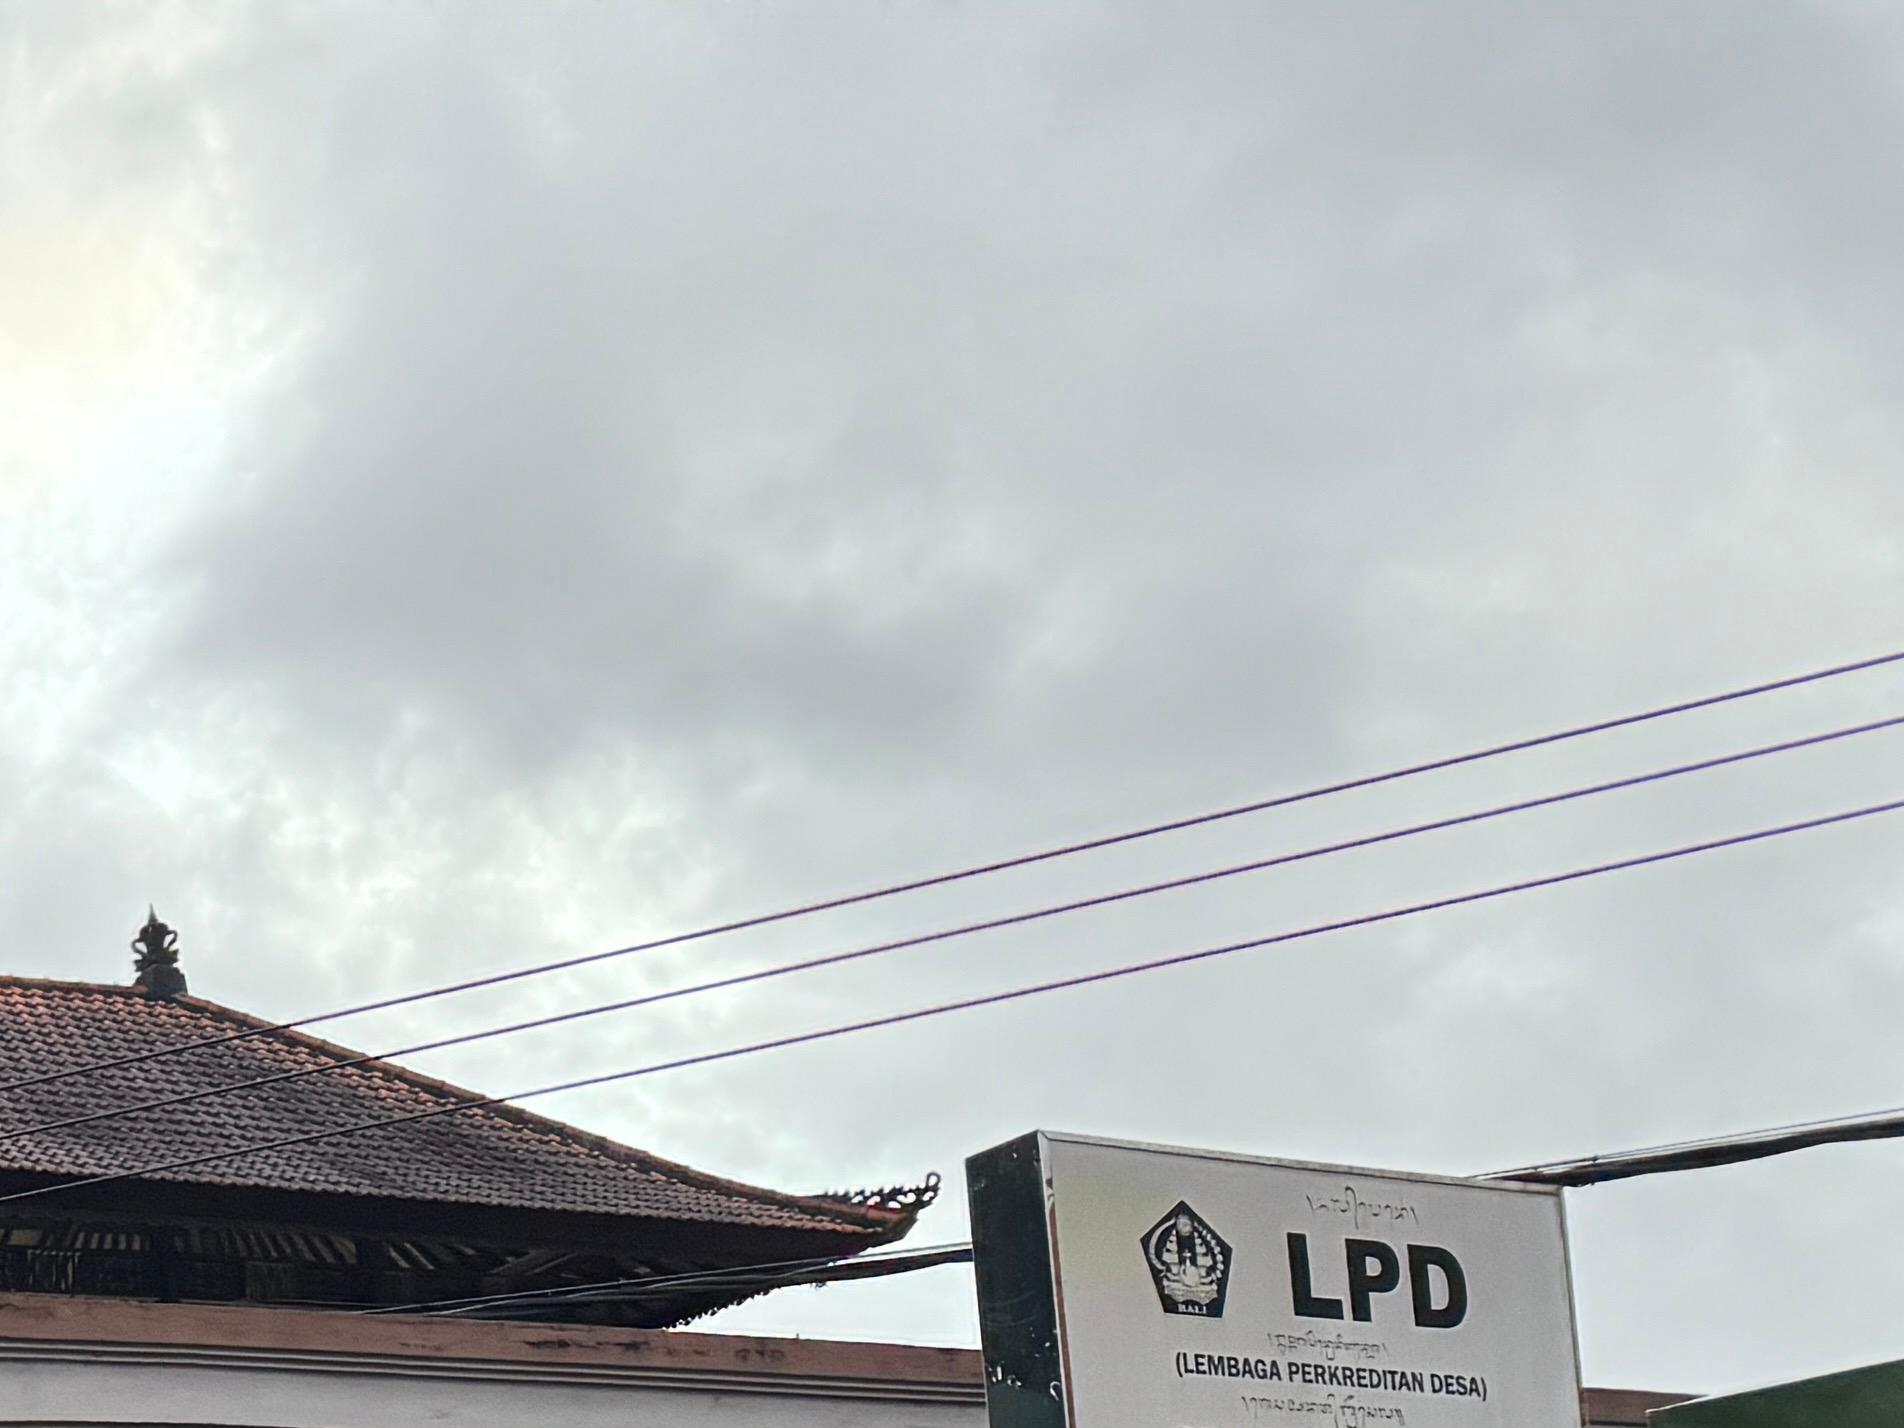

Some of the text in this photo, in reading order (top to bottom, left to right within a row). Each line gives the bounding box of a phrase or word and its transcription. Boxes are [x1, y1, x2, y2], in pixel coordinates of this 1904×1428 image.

[1286, 1231, 1468, 1329] LPD
[1176, 1351, 1487, 1402] (LEMBAGA PERKREDITAN DESA)
